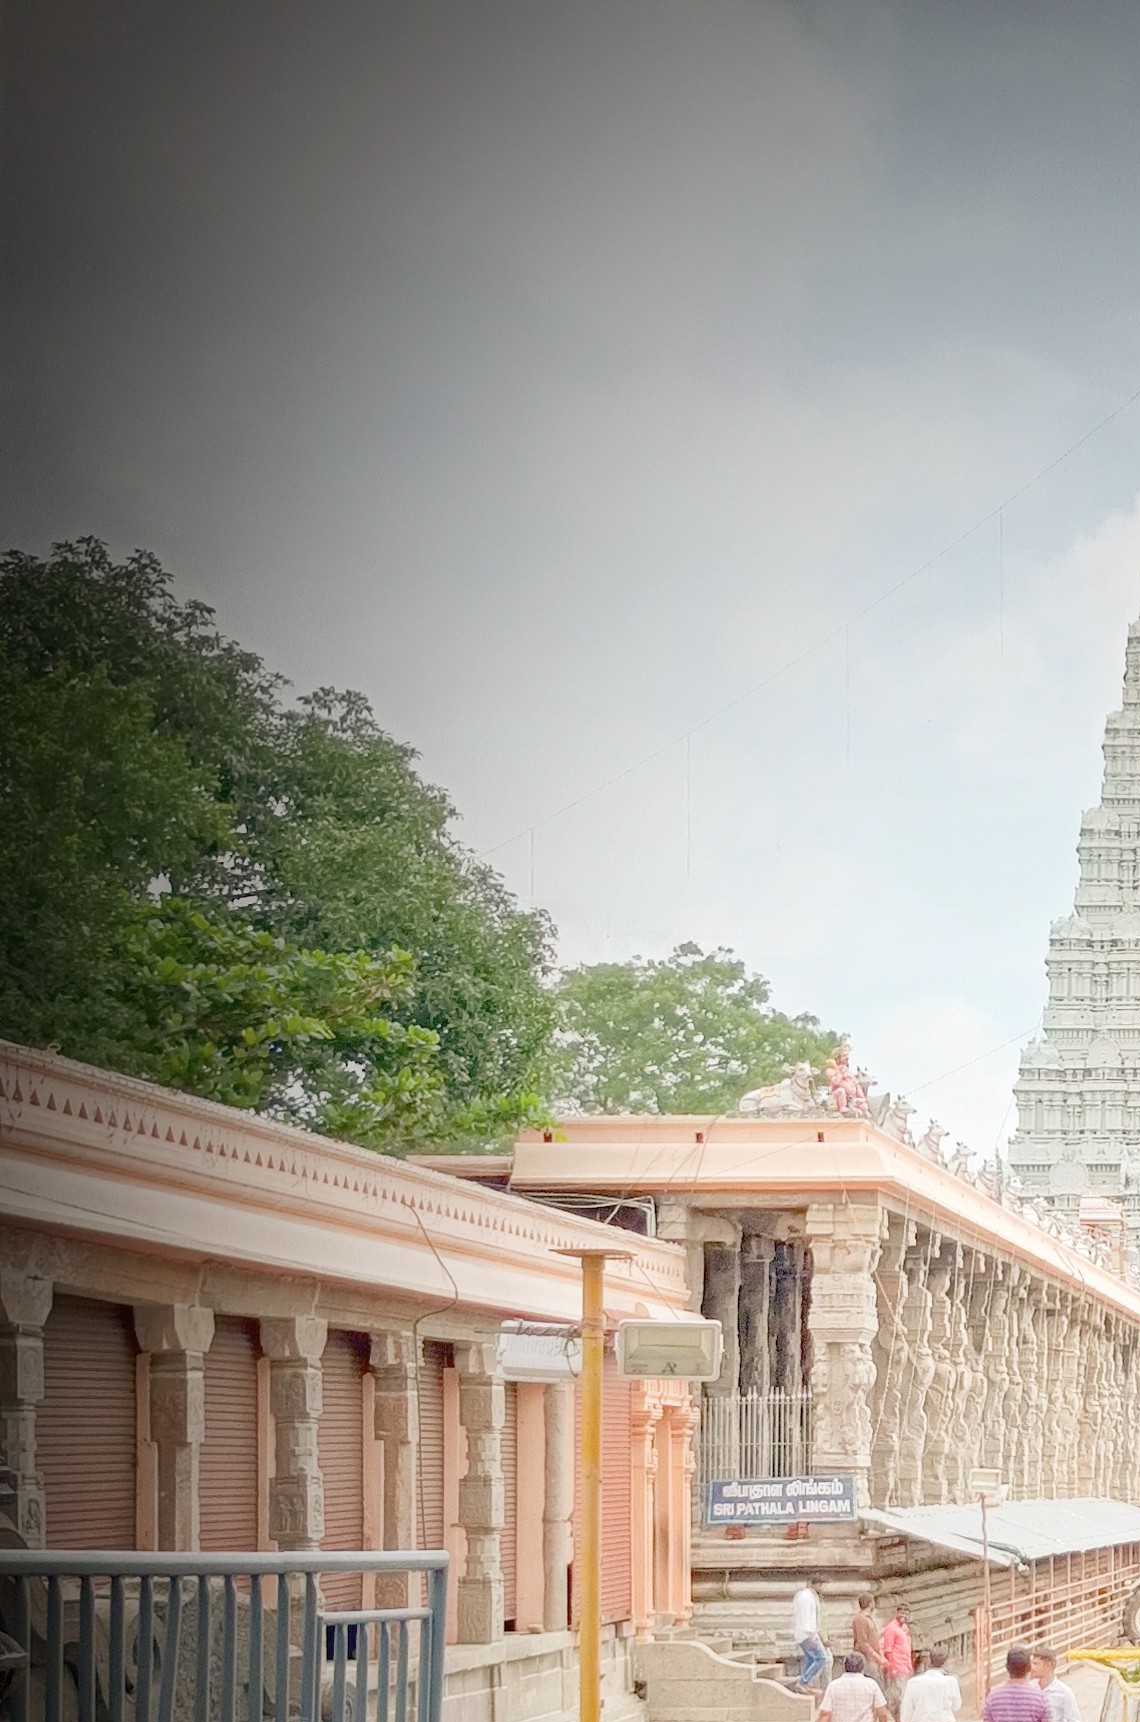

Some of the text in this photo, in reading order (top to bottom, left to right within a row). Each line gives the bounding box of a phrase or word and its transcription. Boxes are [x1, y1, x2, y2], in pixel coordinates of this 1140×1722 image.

[786, 1477, 844, 1497] லிங்கம்
[713, 1499, 851, 1516] SRI PATHALA LINGAM
